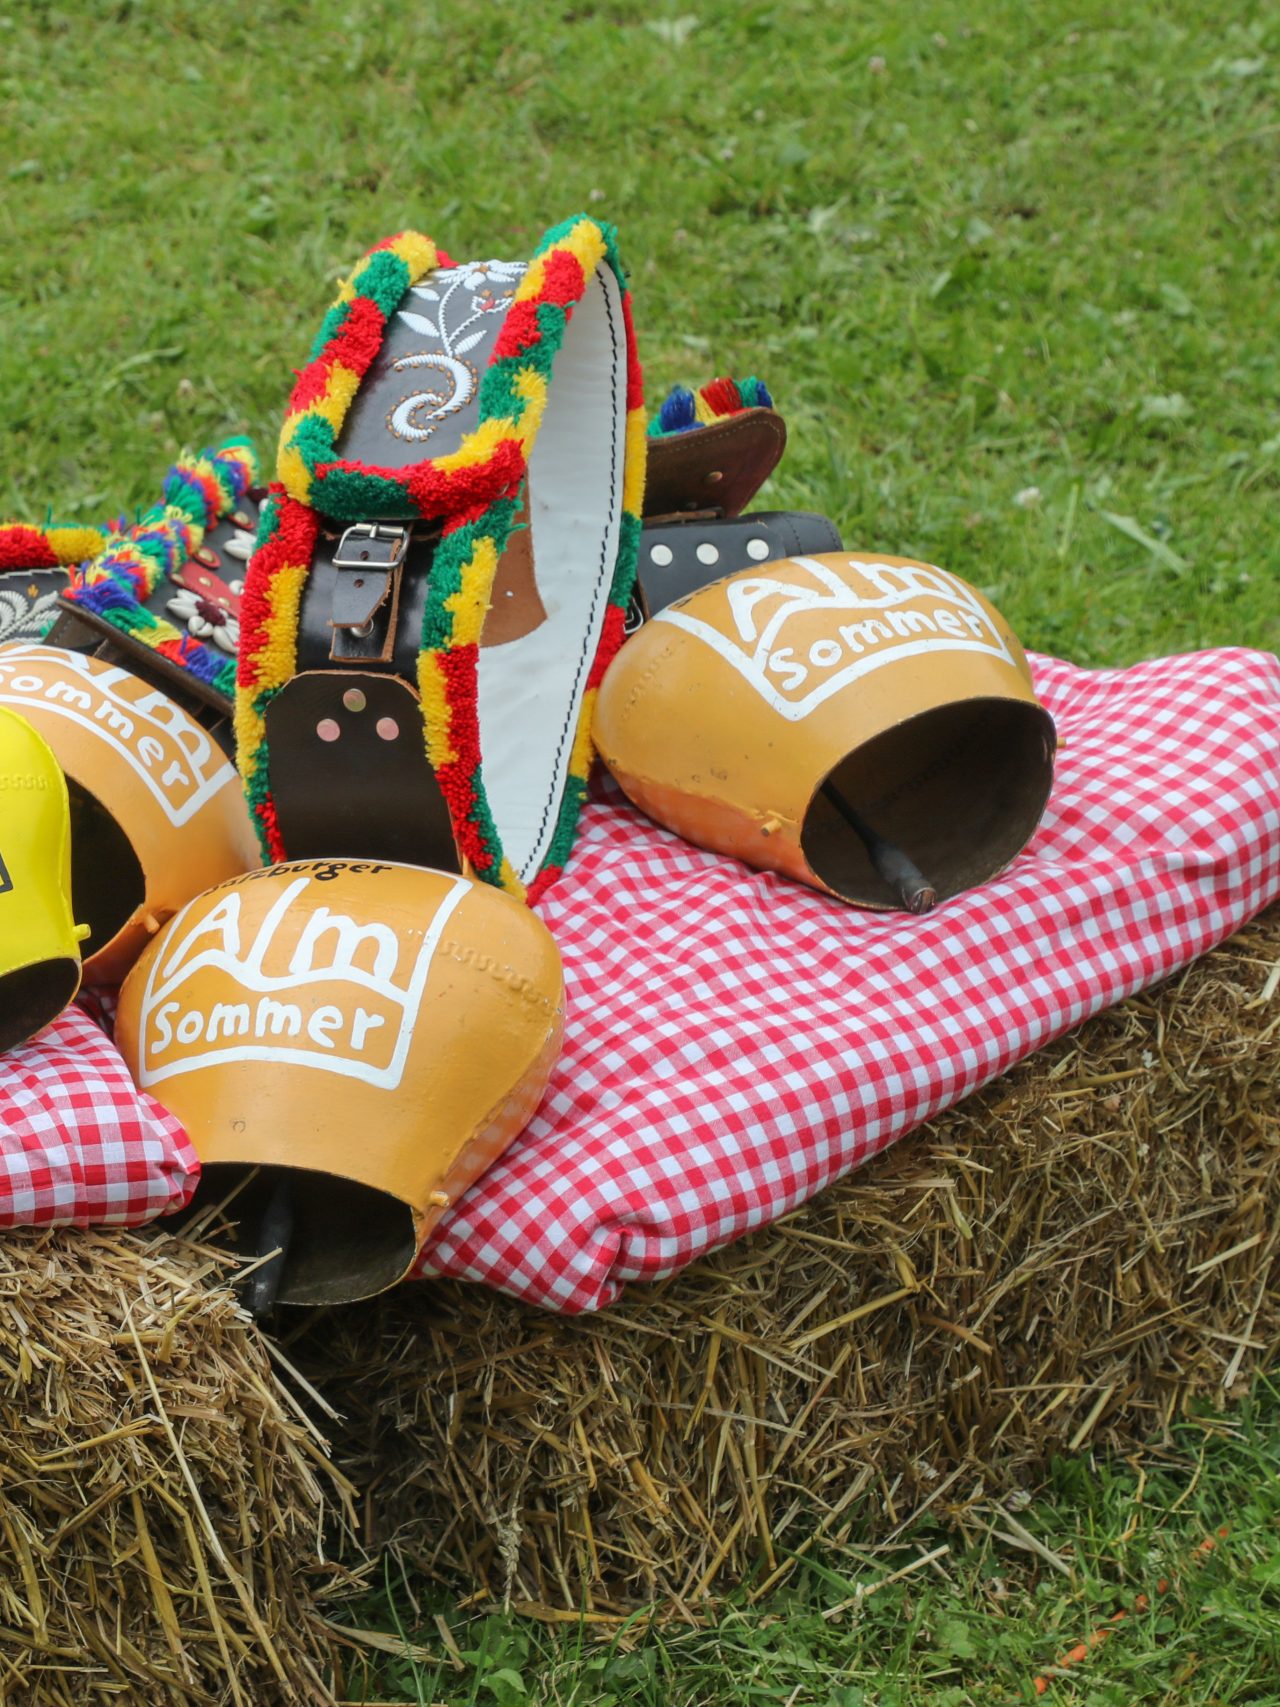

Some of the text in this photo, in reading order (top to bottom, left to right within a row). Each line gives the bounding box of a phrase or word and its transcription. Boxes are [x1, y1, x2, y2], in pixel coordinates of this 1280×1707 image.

[726, 556, 957, 643] Alm
[768, 608, 985, 691] Sommer
[162, 877, 399, 984] Alm
[151, 996, 386, 1055] Sommer
